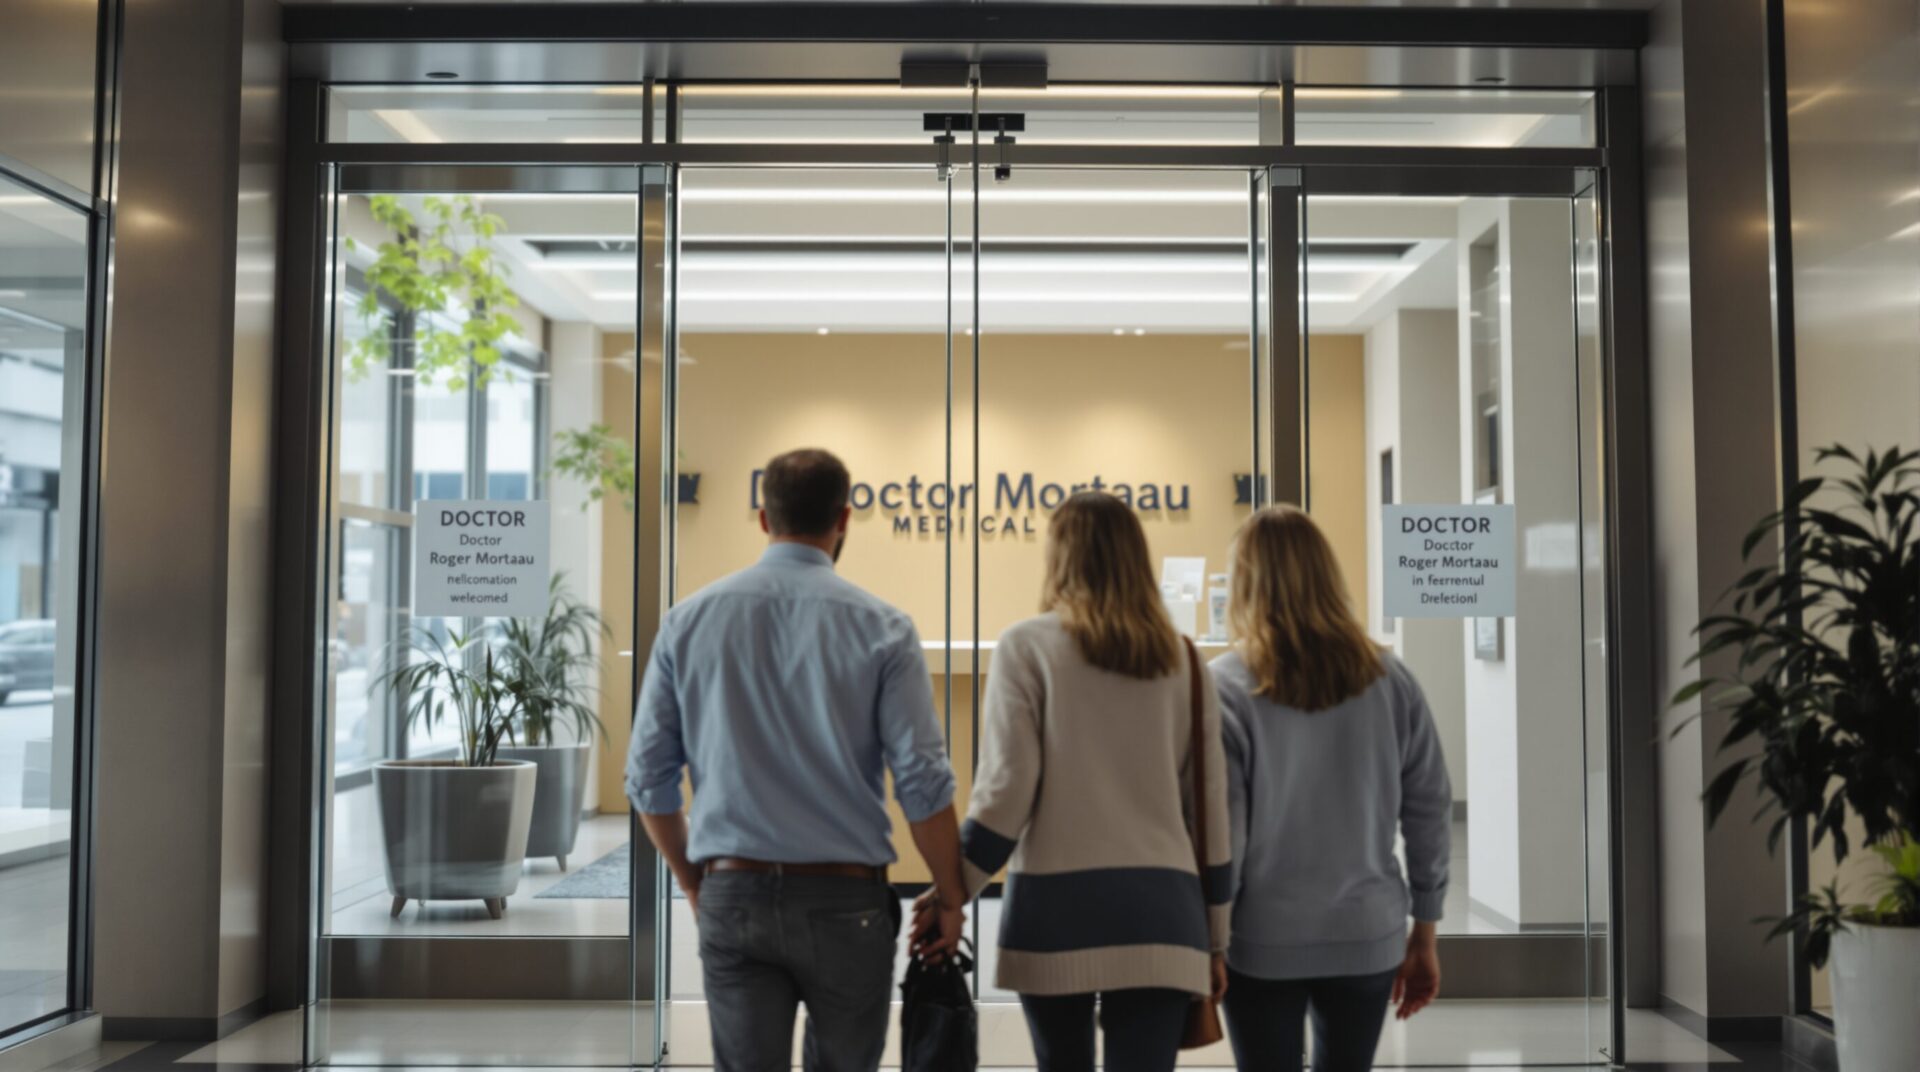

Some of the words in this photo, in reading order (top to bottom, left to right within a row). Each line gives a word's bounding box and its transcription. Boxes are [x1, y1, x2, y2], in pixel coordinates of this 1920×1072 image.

[440, 510, 526, 527] DOCTOR
[893, 515, 1035, 534] MEDICAL
[1401, 516, 1491, 533] DOCTOR
[459, 534, 502, 546] Doctor
[430, 552, 471, 567] Roger
[475, 552, 534, 565] Mortaau
[1398, 555, 1438, 570] Roger
[1442, 556, 1498, 568] Mortaau
[1412, 574, 1424, 586] in
